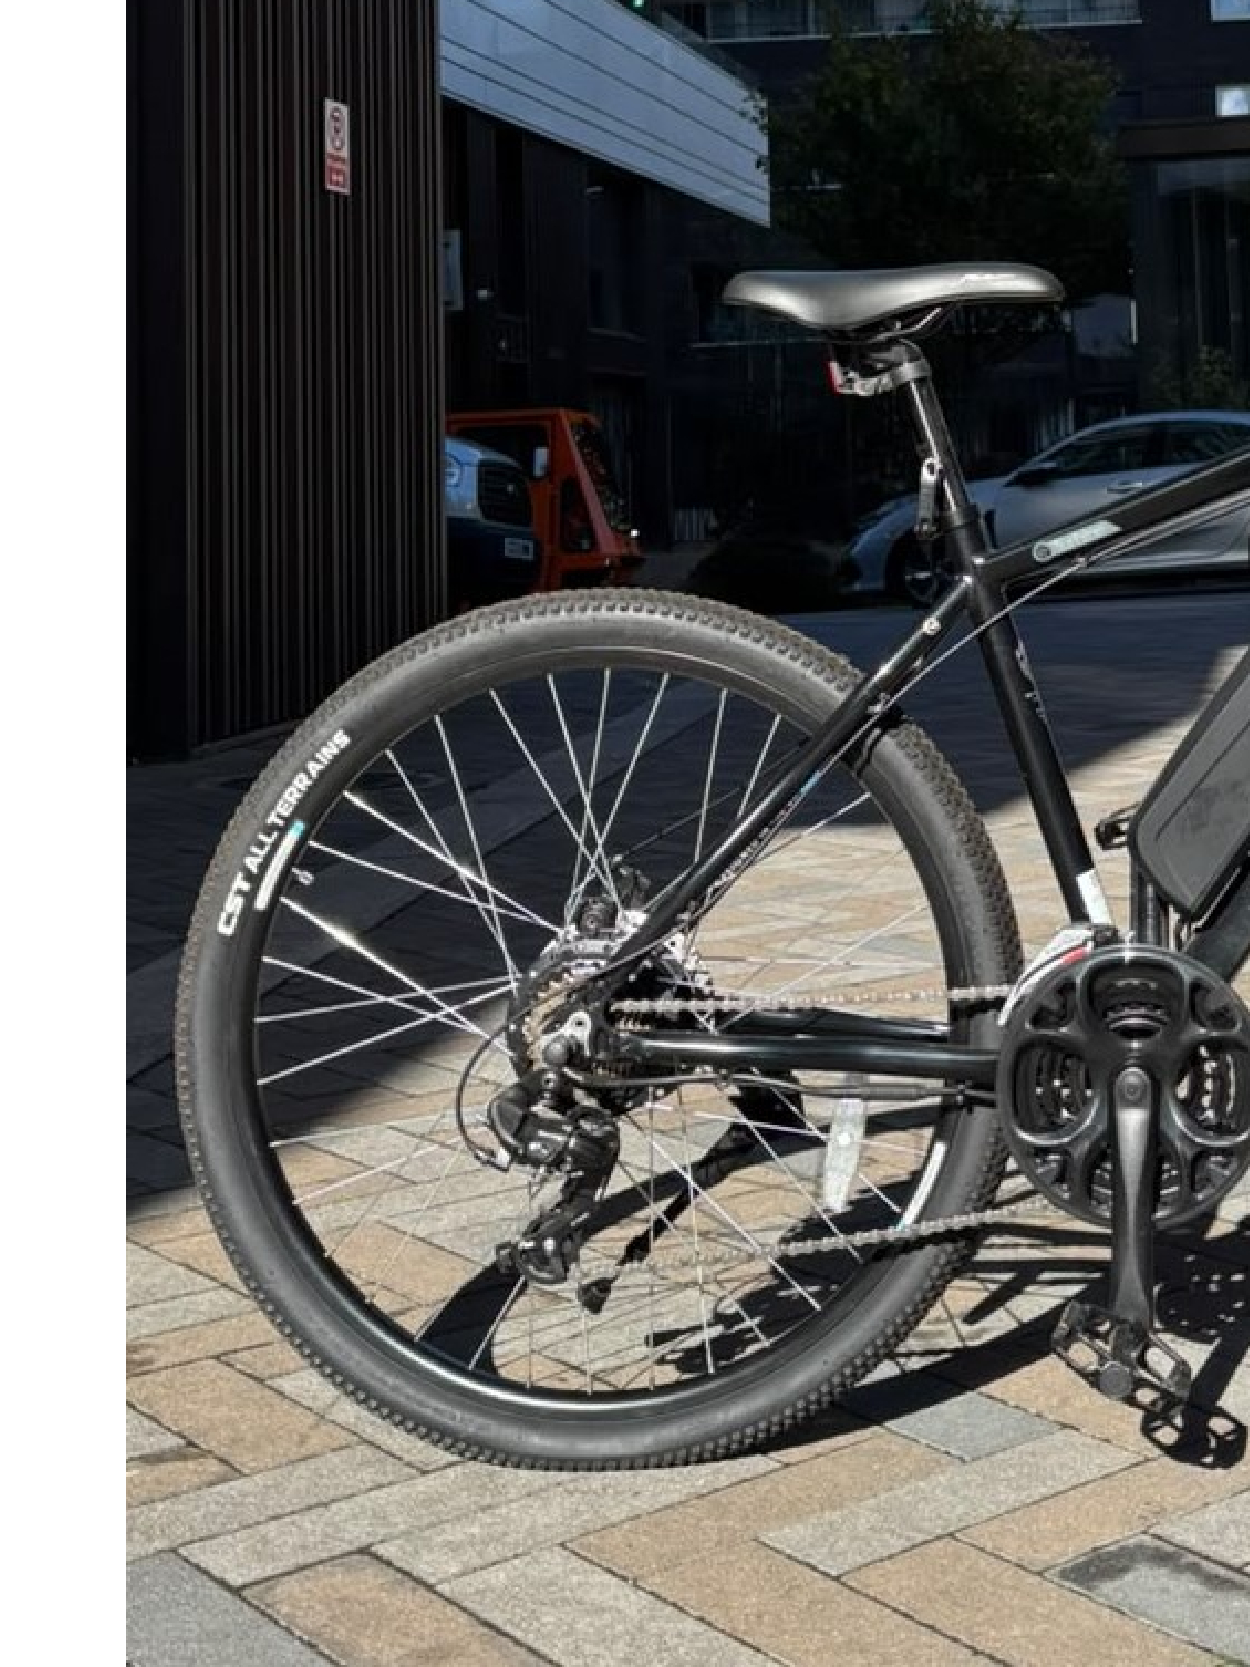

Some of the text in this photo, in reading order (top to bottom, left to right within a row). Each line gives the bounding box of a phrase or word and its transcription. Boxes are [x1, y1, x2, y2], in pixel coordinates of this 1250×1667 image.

[217, 729, 351, 936] CST ALL TERRAINS
